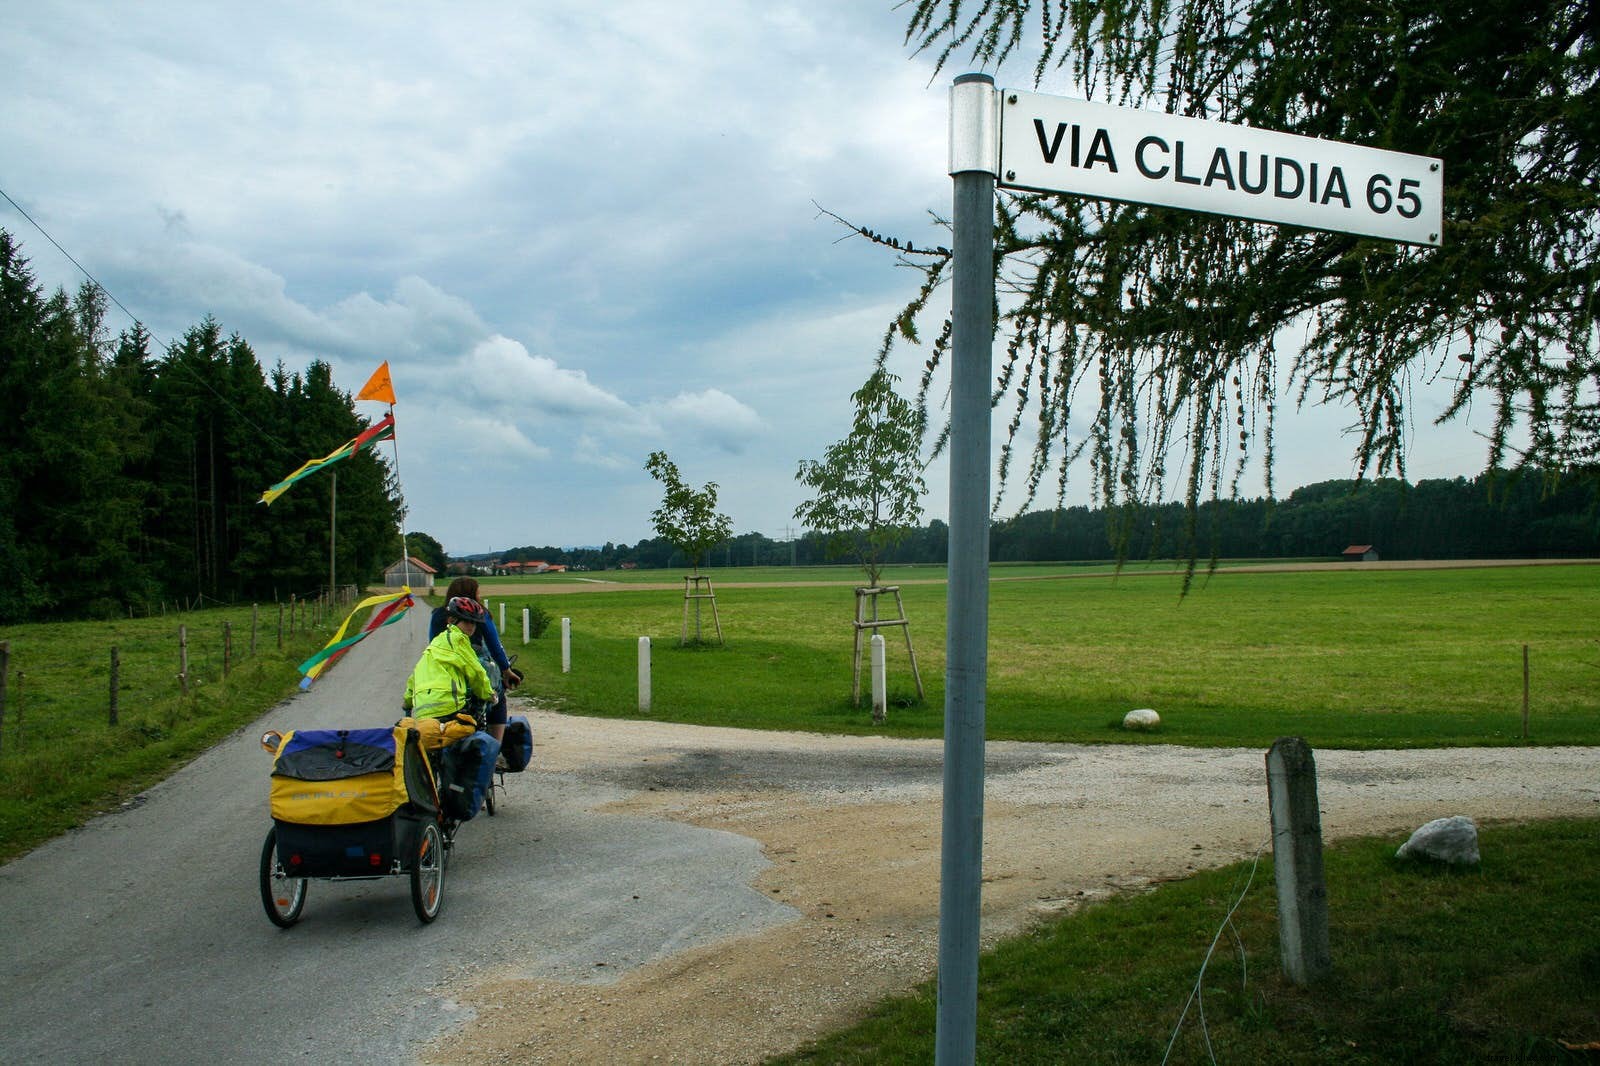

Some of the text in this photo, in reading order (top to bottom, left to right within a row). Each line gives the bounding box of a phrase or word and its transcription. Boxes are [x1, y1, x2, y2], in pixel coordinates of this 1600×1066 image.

[1033, 118, 1422, 219] VIA CLAUDIA 65
